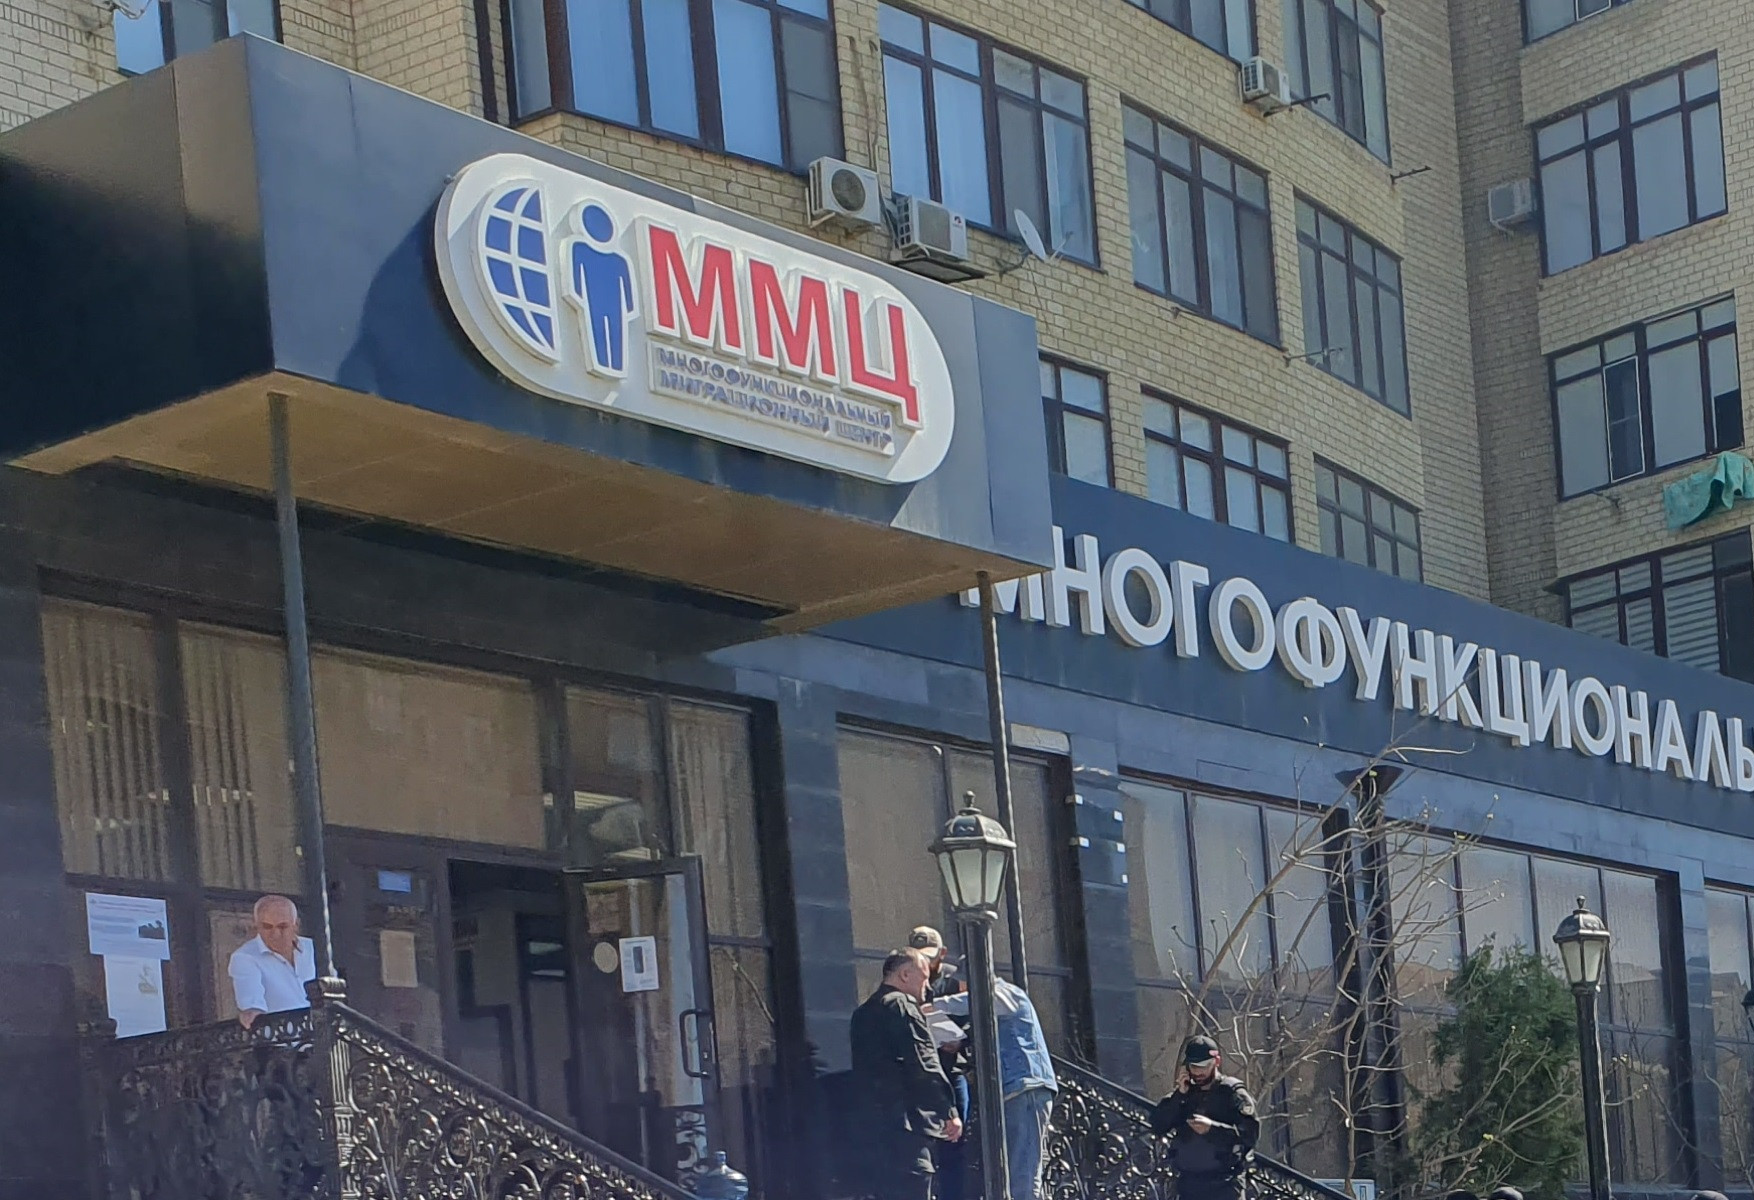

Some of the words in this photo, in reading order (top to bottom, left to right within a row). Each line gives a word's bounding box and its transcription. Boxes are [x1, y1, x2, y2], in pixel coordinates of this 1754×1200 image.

[646, 221, 921, 424] ММЦ
[658, 347, 892, 430] МНОГОФУНКЦИОНАЛЬНЫЙ
[659, 369, 831, 433] МИГРАЦИОННЫЙ
